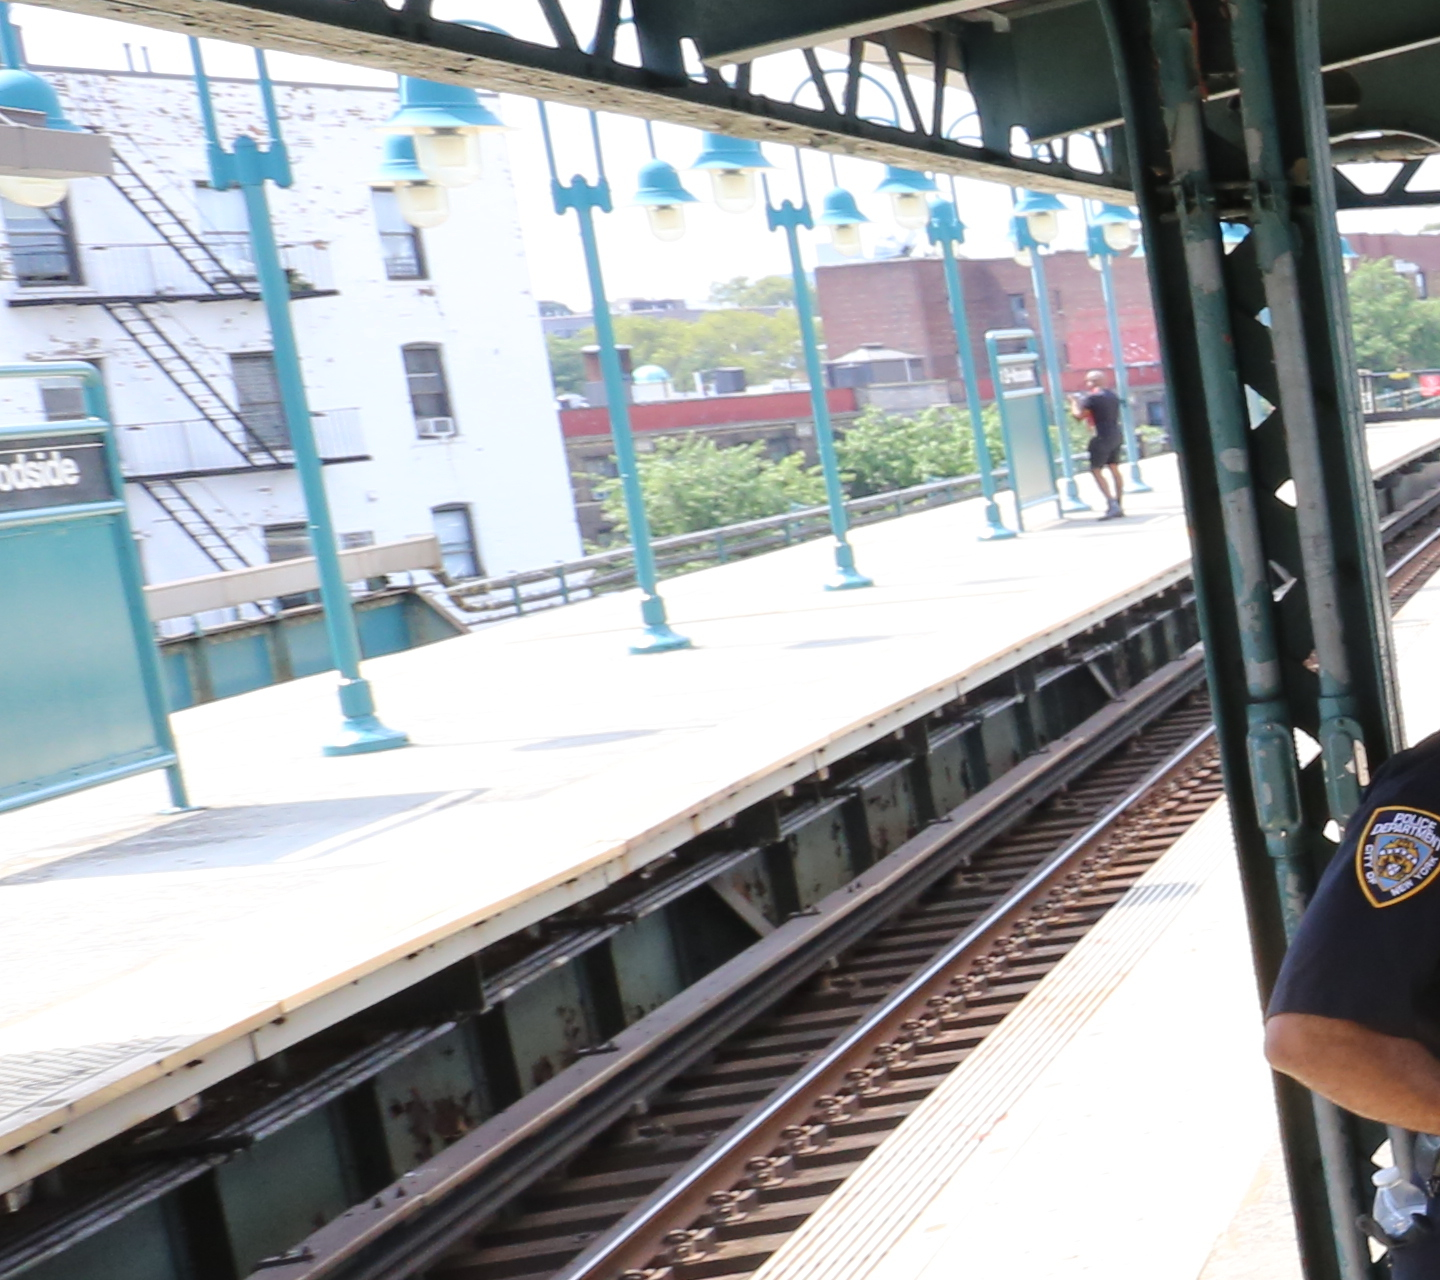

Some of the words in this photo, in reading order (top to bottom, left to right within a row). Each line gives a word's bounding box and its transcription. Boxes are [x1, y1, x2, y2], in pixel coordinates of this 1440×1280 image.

[1393, 812, 1438, 830] POLICE
[1363, 843, 1374, 868] CITY
[1414, 855, 1439, 880] YORK
[1365, 871, 1378, 885] OF
[1390, 879, 1414, 897] NEW
